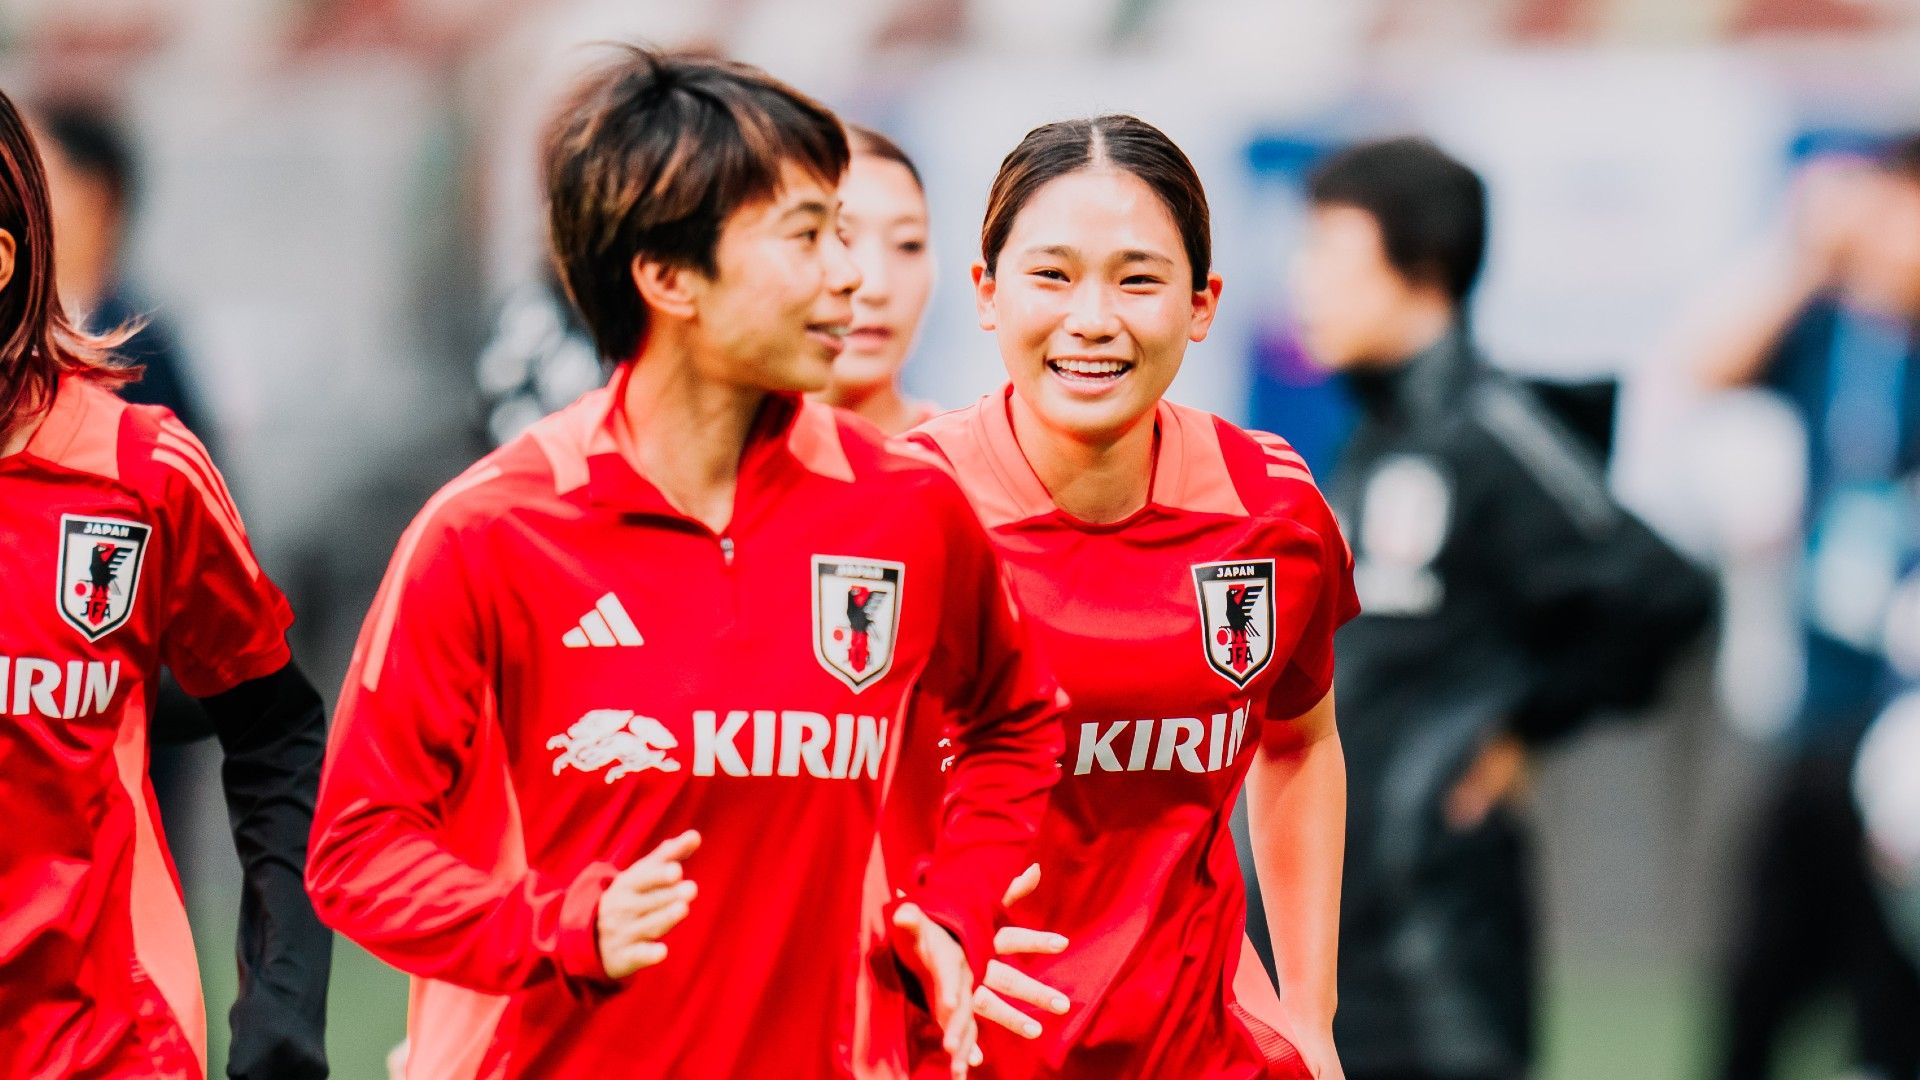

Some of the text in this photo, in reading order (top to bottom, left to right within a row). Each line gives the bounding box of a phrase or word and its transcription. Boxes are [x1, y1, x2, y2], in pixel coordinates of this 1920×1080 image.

[83, 522, 130, 537] JAPAN
[1216, 566, 1255, 578] JAPAN
[80, 601, 110, 618] JFA
[1225, 646, 1254, 665] JFA
[0, 655, 120, 719] IRIN
[692, 710, 888, 780] KIRIN
[1074, 698, 1250, 775] KIRIN
